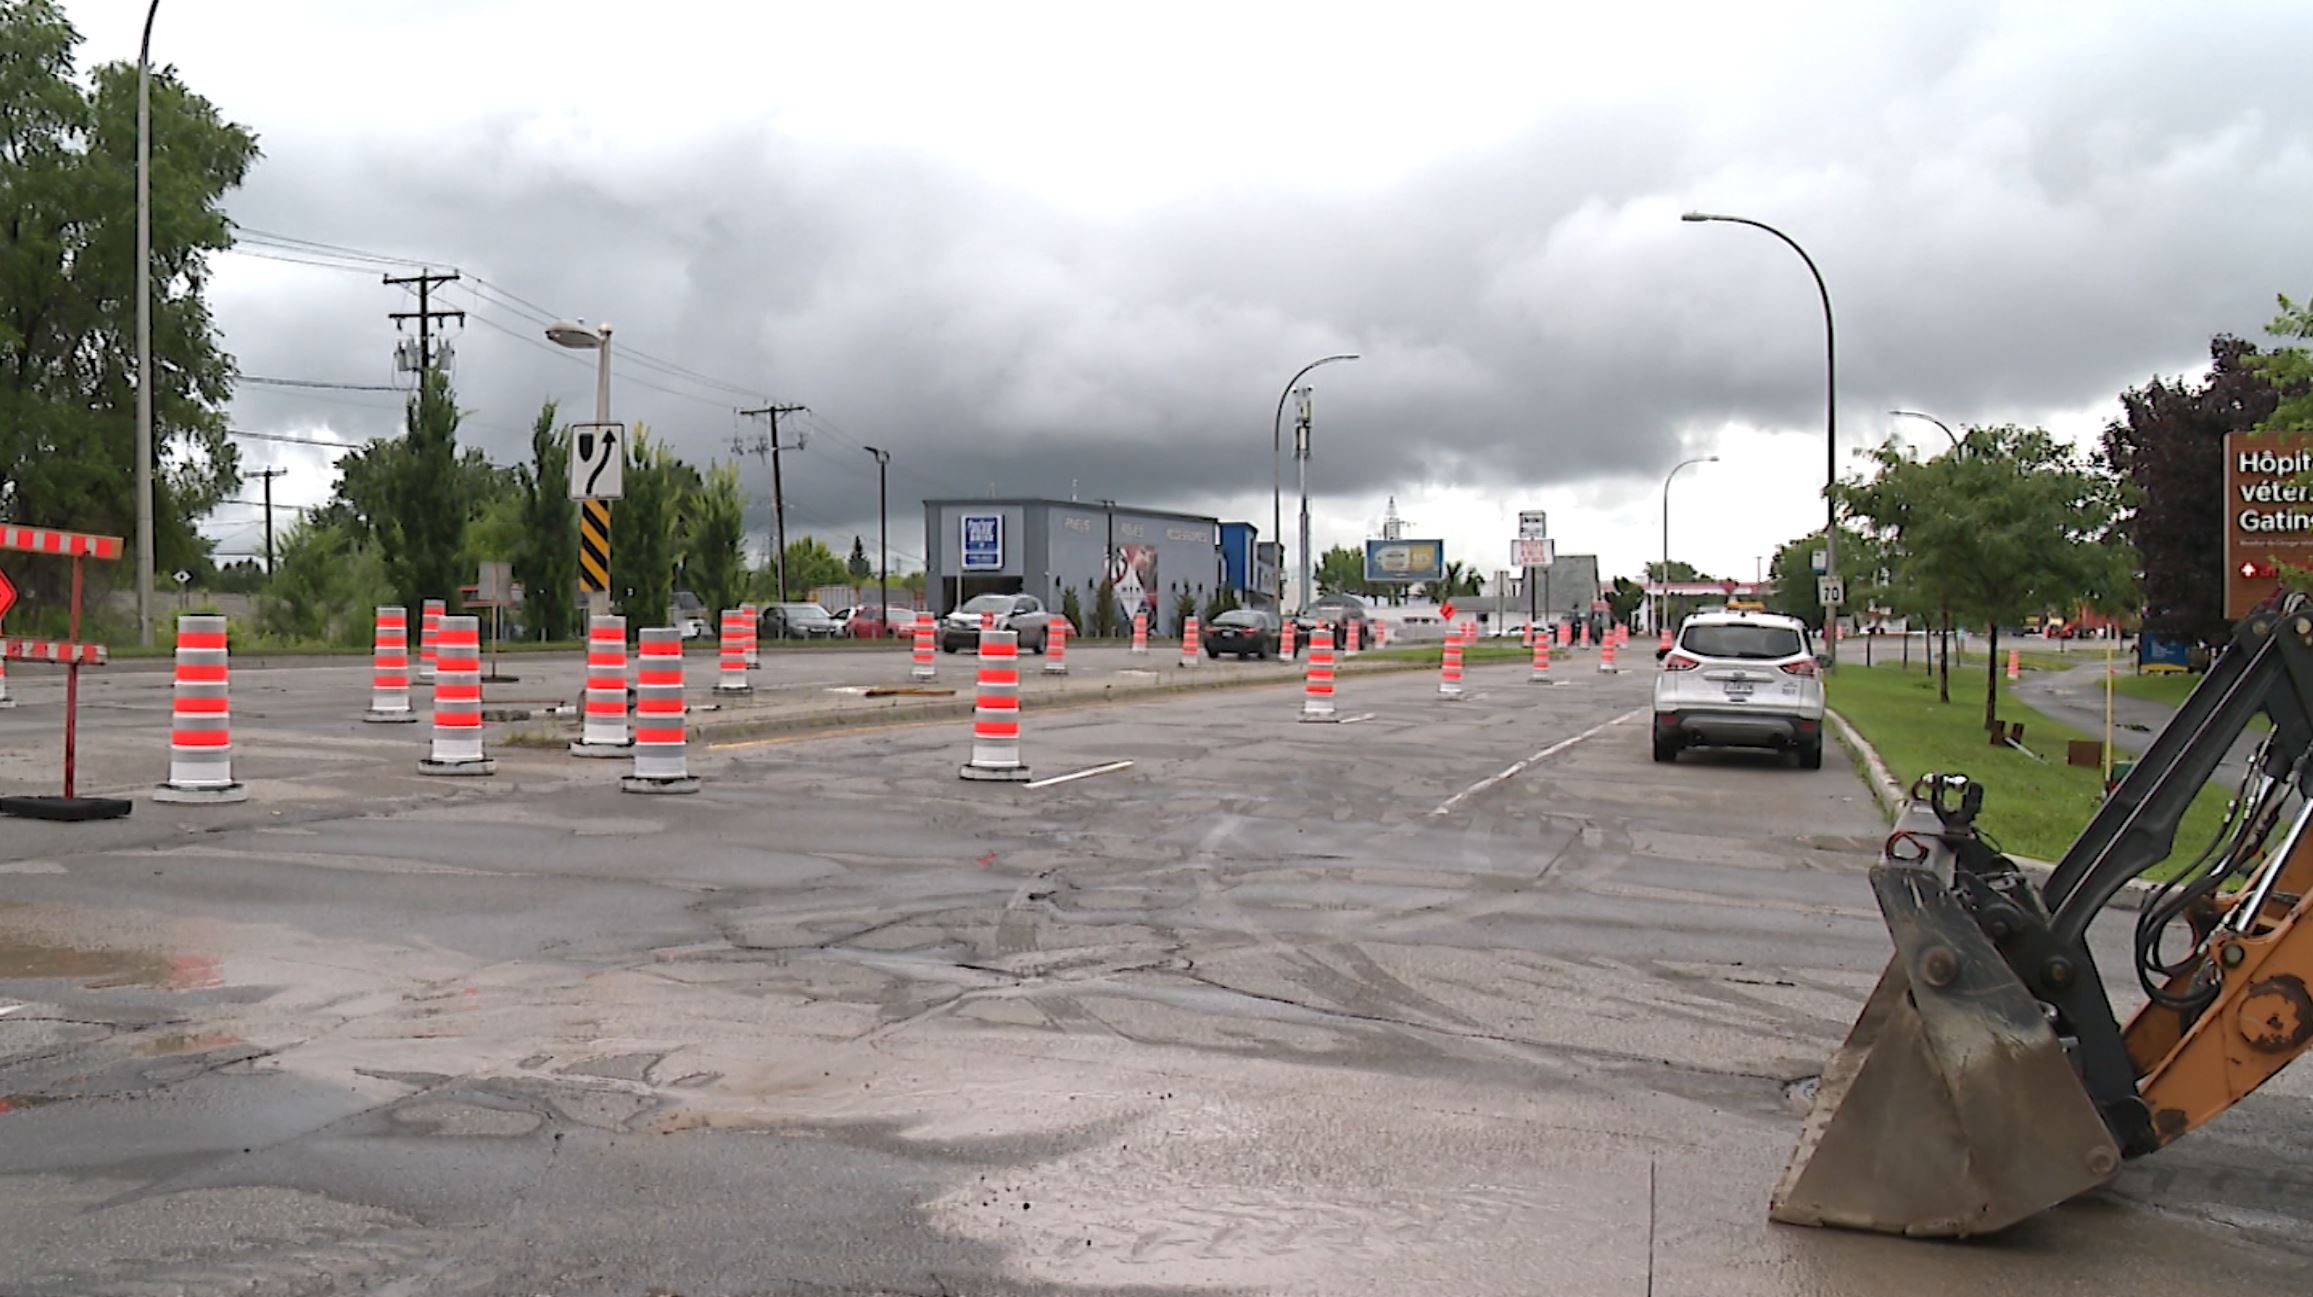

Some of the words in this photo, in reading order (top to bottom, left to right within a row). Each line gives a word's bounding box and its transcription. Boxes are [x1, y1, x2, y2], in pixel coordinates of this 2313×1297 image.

[2239, 450, 2313, 477] Hôpit
[2239, 509, 2313, 532] Gatin
[1824, 587, 1838, 600] 70
